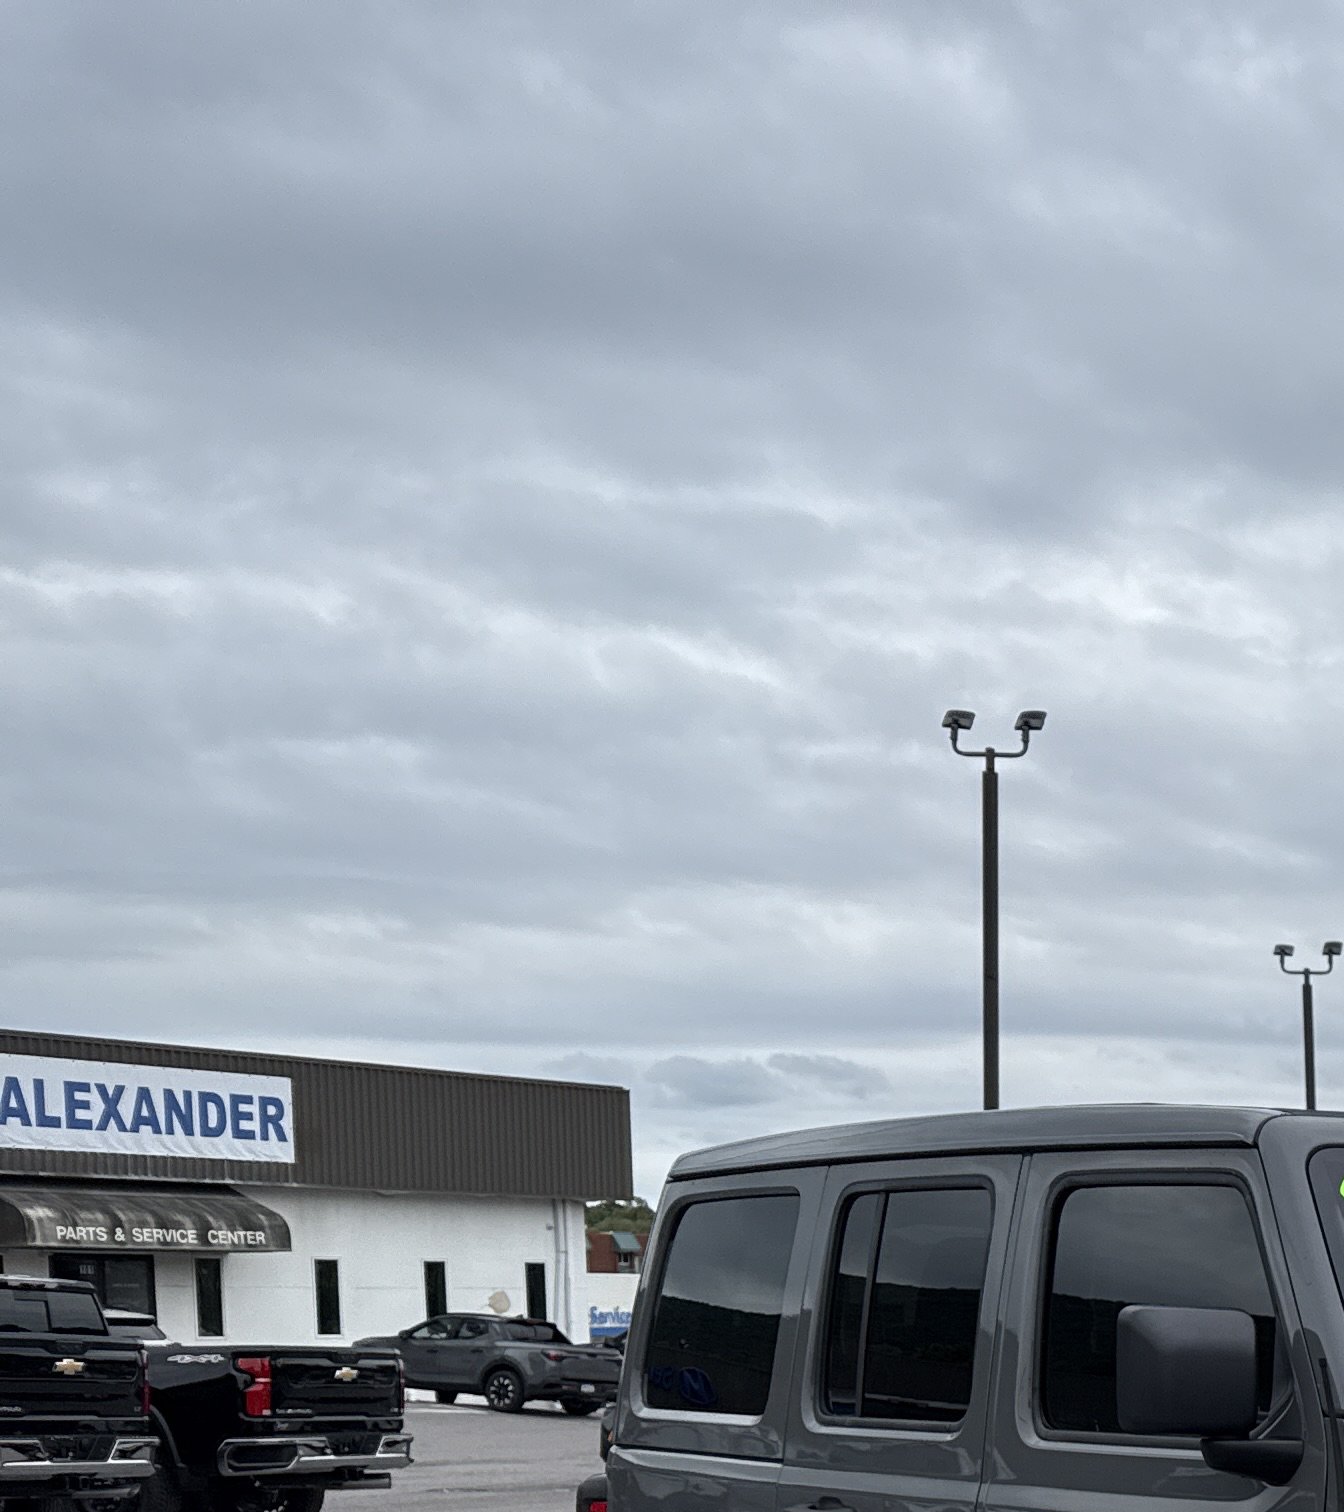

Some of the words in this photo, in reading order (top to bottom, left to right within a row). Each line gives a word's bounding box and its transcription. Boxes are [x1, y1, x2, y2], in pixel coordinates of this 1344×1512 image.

[0, 1076, 288, 1142] ALEXANDER
[56, 1226, 108, 1242] PARTS
[114, 1228, 125, 1242] &
[132, 1228, 198, 1244] SERVICE
[207, 1229, 266, 1245] CENTER
